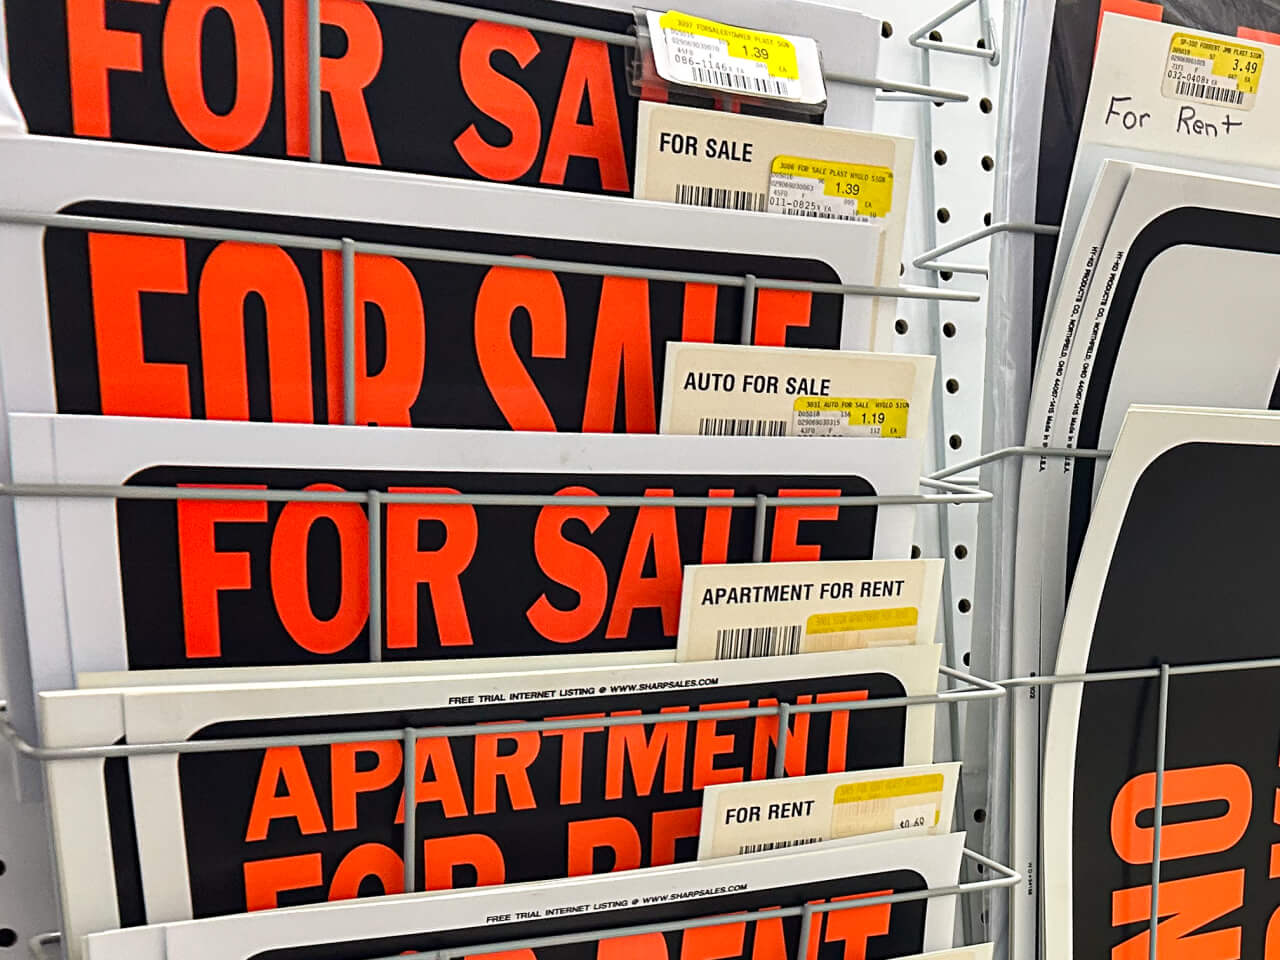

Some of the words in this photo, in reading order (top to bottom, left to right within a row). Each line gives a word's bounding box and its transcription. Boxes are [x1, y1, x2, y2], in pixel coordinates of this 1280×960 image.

[742, 45, 769, 60] 1.39
[1232, 59, 1258, 74] 3.49
[66, 0, 383, 166] FOR
[1105, 95, 1151, 130] For
[1176, 105, 1243, 138] Rent
[660, 133, 697, 156] FOR
[706, 138, 752, 162] SALE
[835, 182, 860, 196] 1.39
[88, 232, 426, 427] FOR
[684, 372, 735, 392] AUTO
[742, 375, 779, 394] FOR
[785, 376, 830, 396] SALE
[861, 412, 885, 424] 1.19
[176, 482, 479, 659] FOR
[702, 584, 814, 605] APARTMENT
[820, 582, 853, 599] FOR
[860, 580, 905, 597] RENT
[510, 690, 556, 700] INTERNET
[559, 687, 595, 697] LISTING
[610, 678, 719, 692] WWW.SHARPSALES.COM
[245, 690, 869, 842] APARTMENT
[726, 806, 760, 824] FOR
[768, 800, 815, 820] RENT
[516, 911, 541, 919] TRIAL
[545, 905, 590, 916] INTERNET
[594, 900, 627, 909] LISTING
[642, 884, 748, 904] WWW.SHARPSALES.COM
